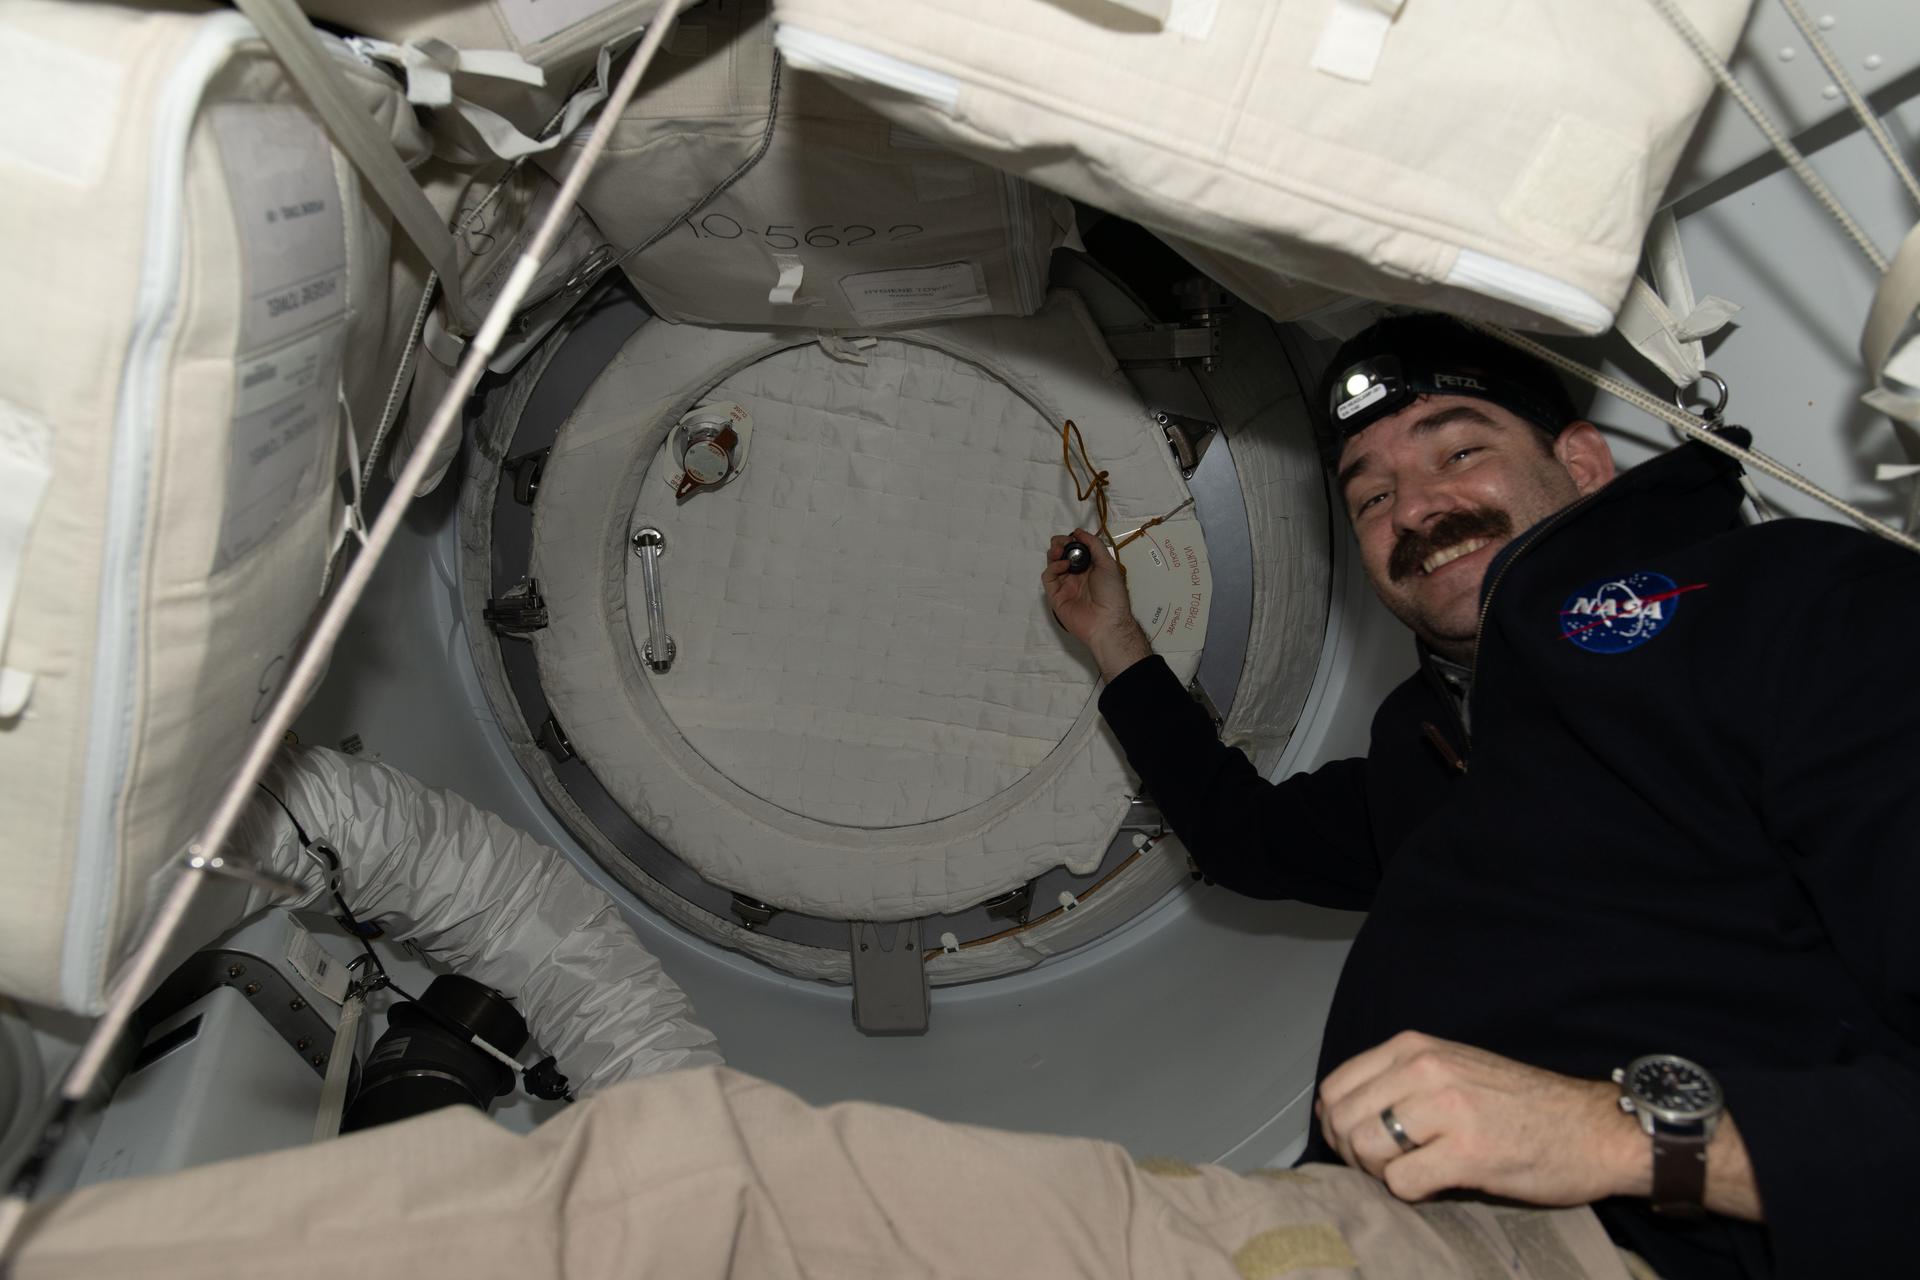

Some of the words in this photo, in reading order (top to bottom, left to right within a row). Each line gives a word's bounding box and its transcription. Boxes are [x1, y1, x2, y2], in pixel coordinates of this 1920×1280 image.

[1433, 373, 1488, 391] PETZL
[1150, 550, 1161, 566] OPEN
[1164, 538, 1181, 568] ОТКРЫТЬ
[1183, 545, 1200, 586] КРЫШКИ
[1151, 606, 1163, 625] CLOSE
[1166, 606, 1183, 636] ЗАКРЫТЬ
[1184, 593, 1202, 631] ПРИВОД
[1569, 597, 1664, 621] NASA
